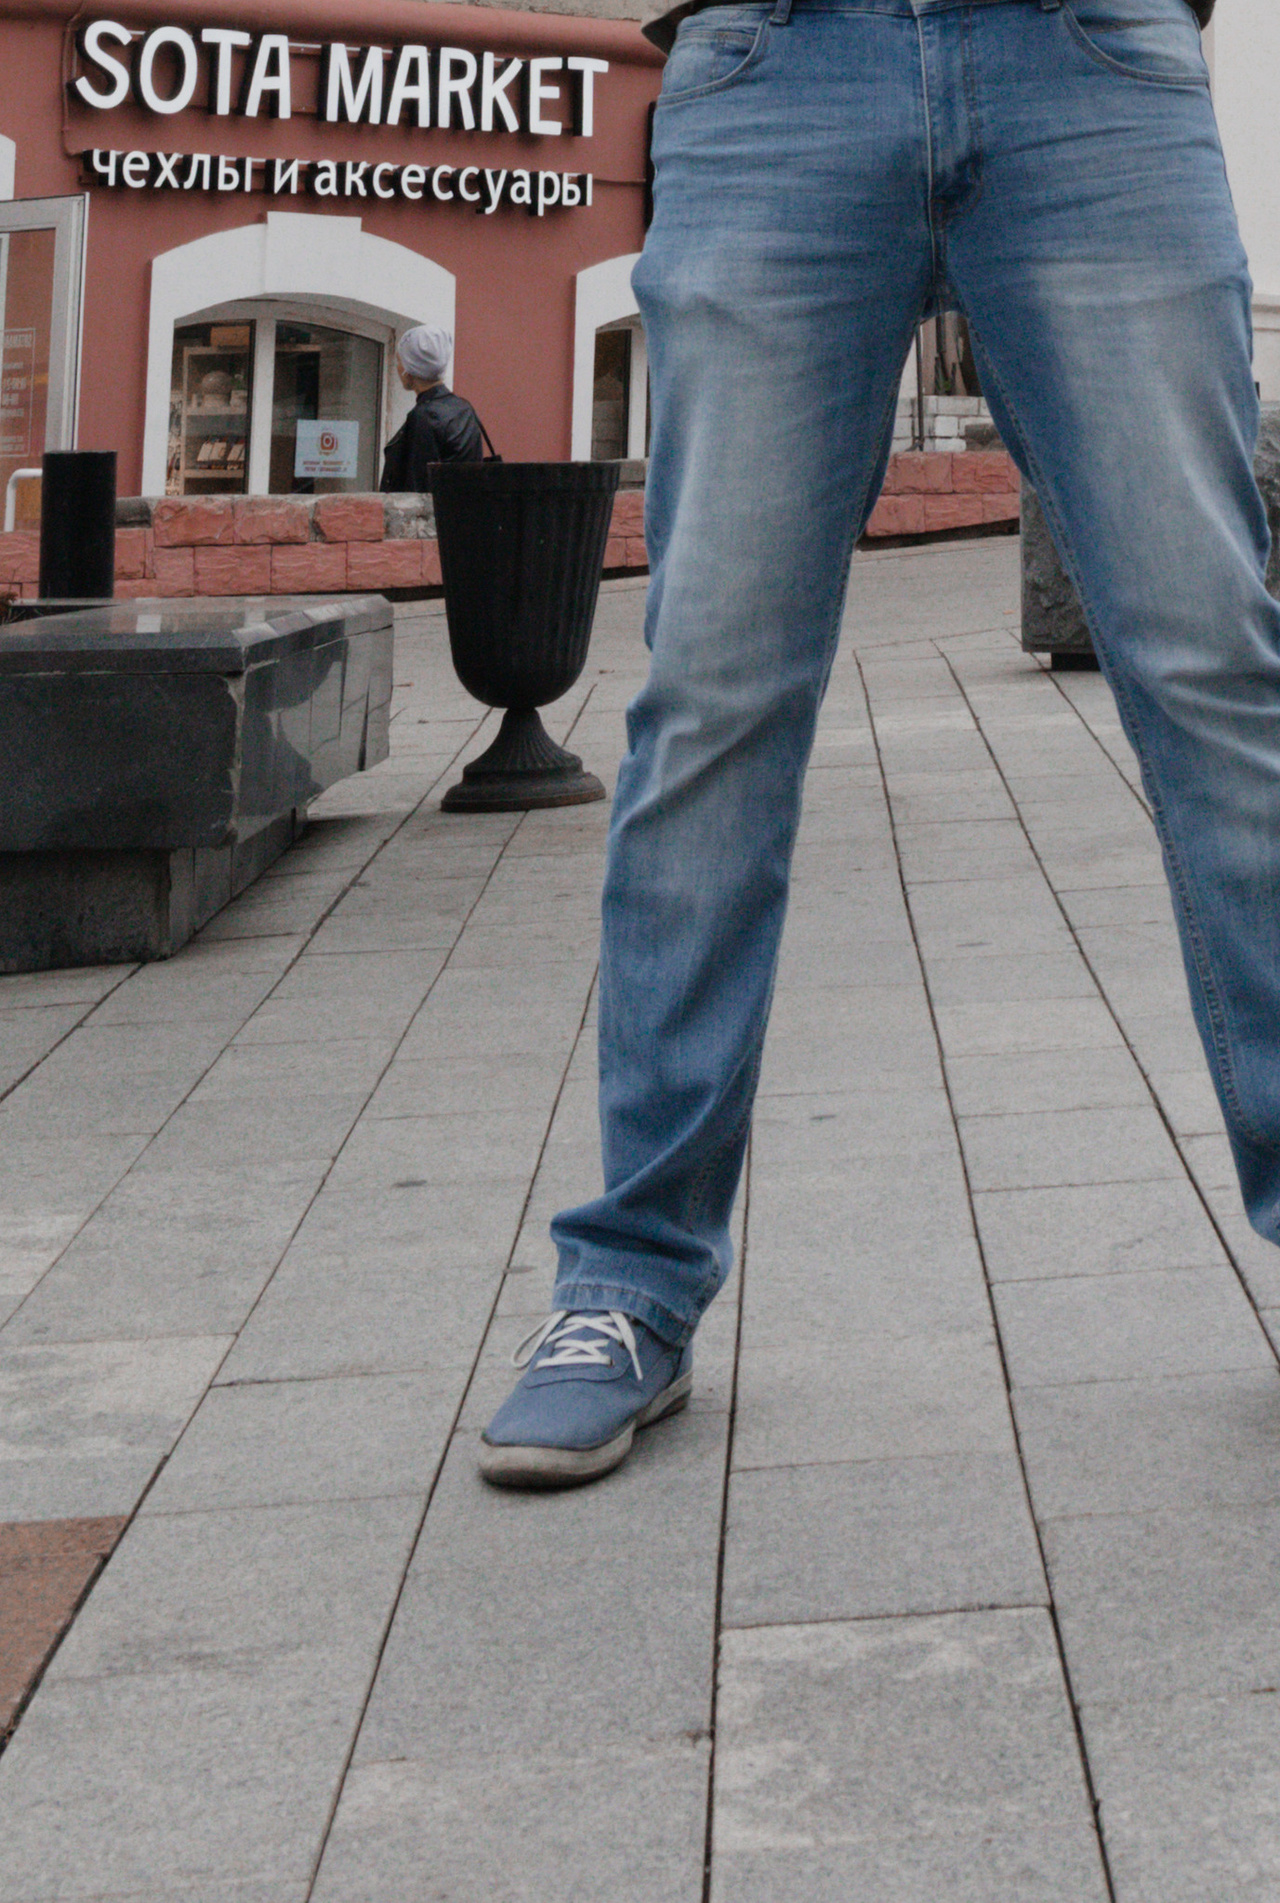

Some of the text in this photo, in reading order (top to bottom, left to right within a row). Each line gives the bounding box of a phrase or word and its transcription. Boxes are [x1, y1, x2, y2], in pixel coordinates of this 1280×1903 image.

[75, 19, 609, 137] SOTA MARKET
[92, 148, 593, 217] чехлы и аксессуары
